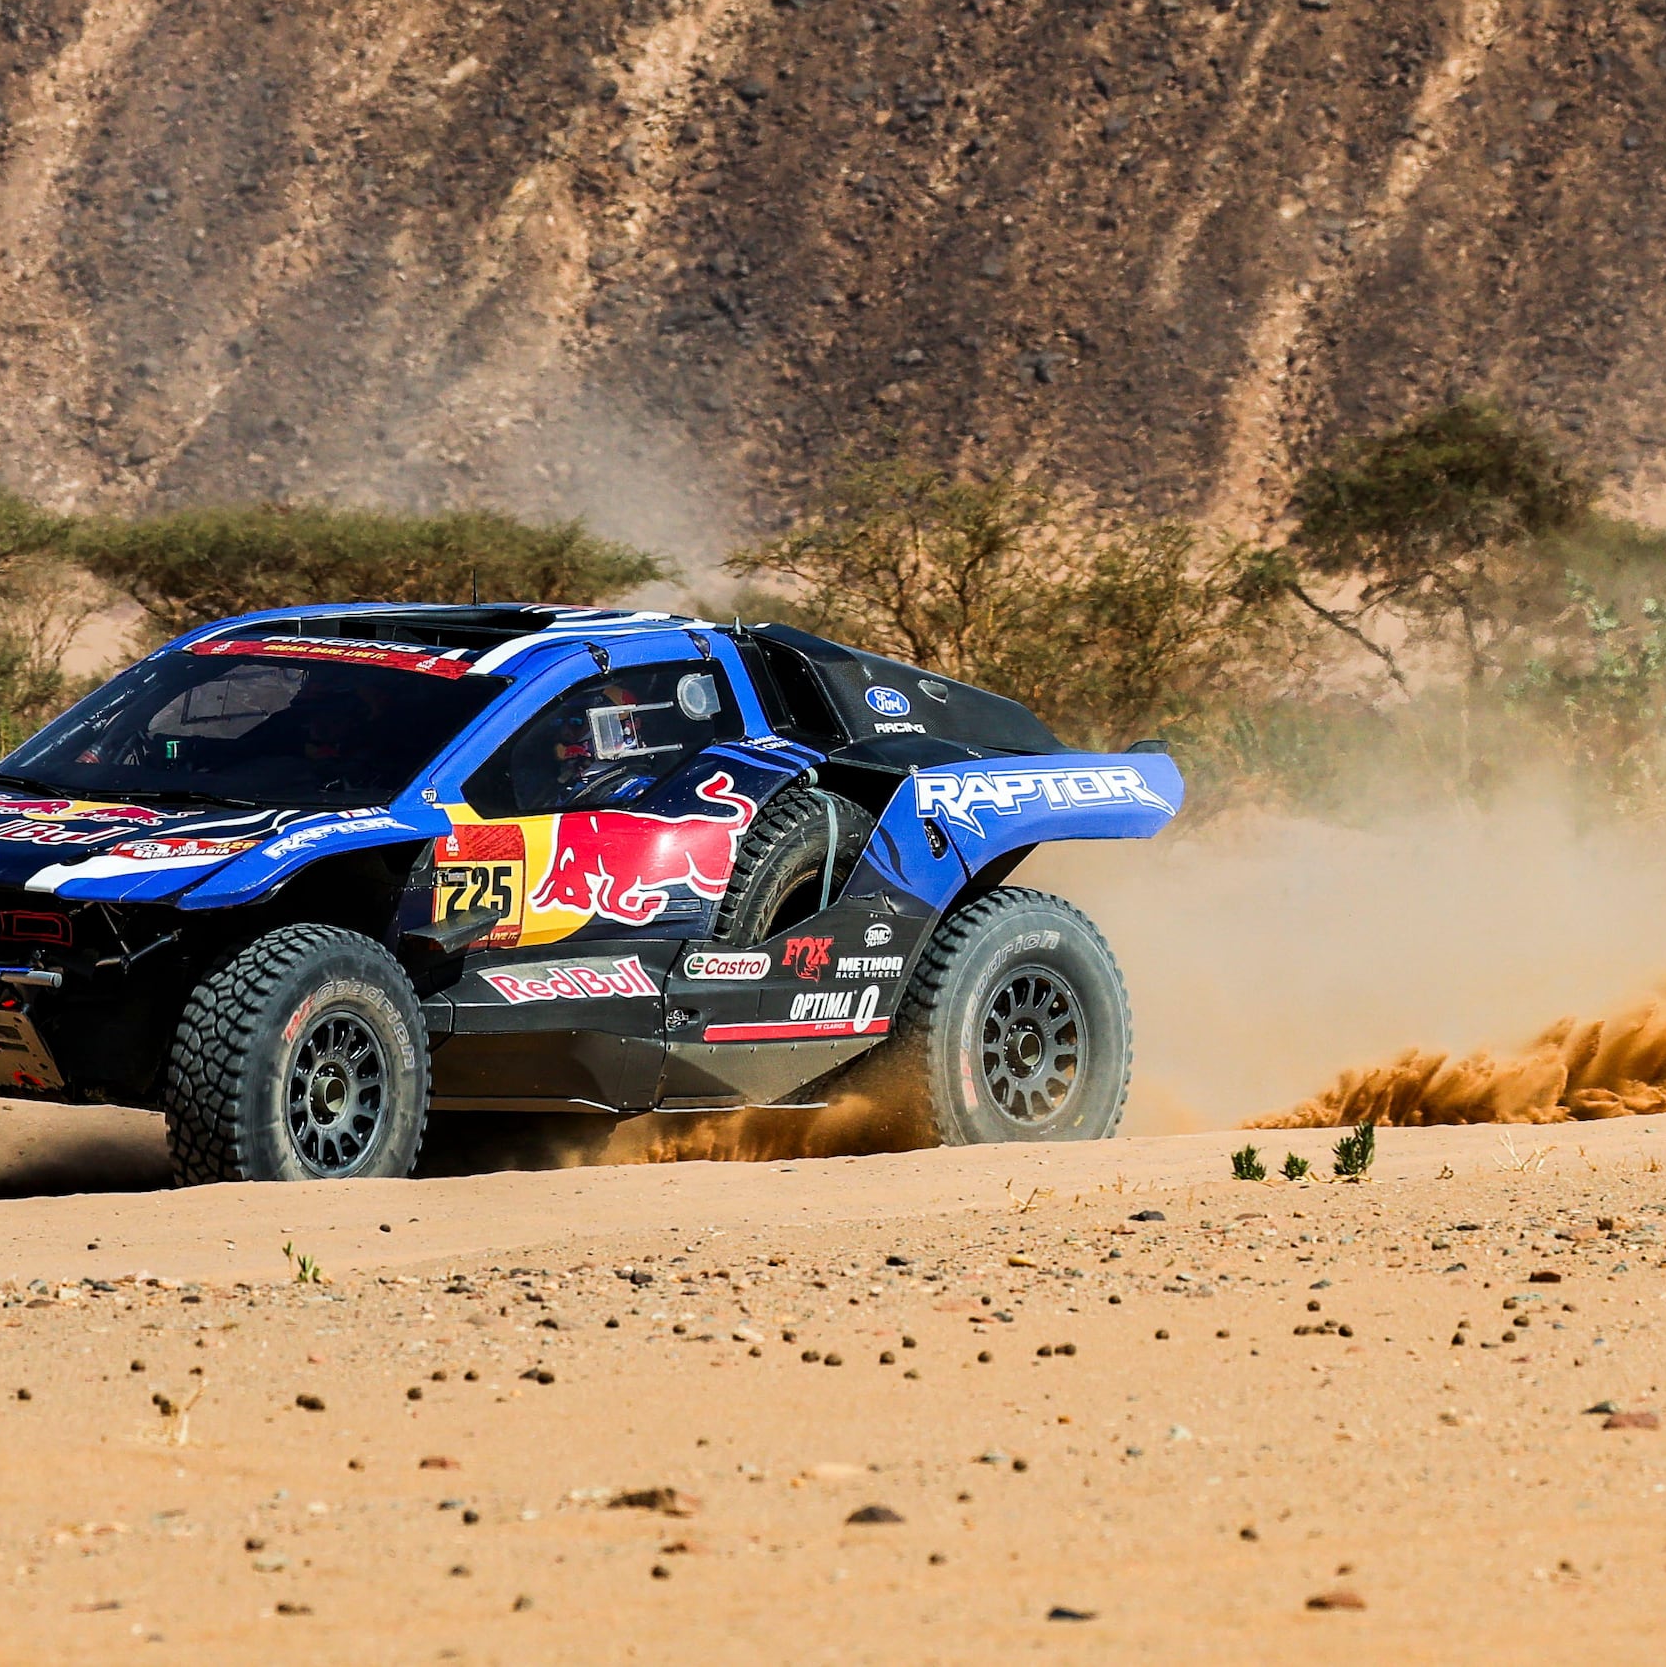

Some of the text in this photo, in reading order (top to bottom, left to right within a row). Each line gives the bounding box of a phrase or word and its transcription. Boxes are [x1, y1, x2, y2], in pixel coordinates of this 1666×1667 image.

[872, 689, 904, 712] Ford
[874, 722, 926, 733] RACING
[914, 766, 1176, 838] RAPTOR
[262, 816, 417, 859] RAPTOR
[782, 935, 834, 968] FOX
[837, 956, 904, 971] METHOD
[705, 957, 768, 976] Castrol
[790, 991, 853, 1021] OPTIMA
